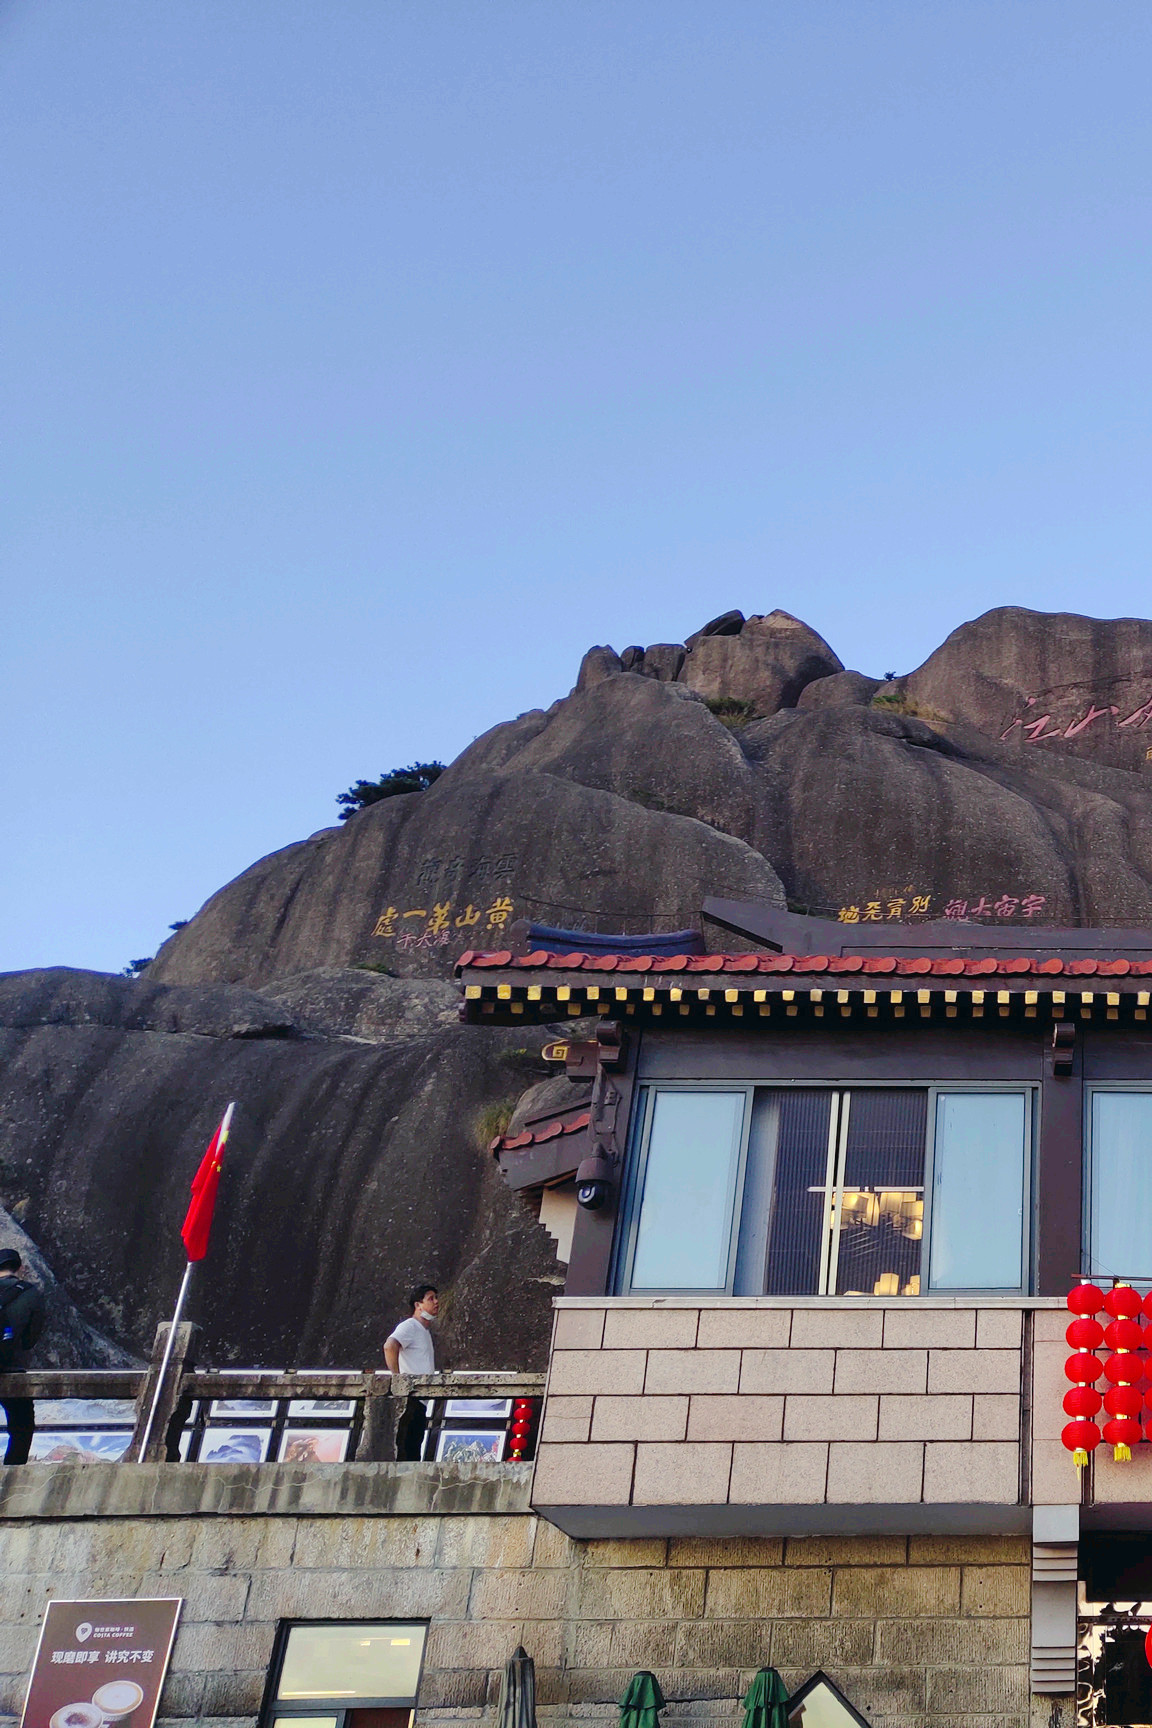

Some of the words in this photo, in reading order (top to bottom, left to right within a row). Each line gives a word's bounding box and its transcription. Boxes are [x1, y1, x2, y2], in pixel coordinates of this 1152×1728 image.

[50, 1651, 100, 1664] 现磨即享
[104, 1650, 155, 1663] 讲究不变
